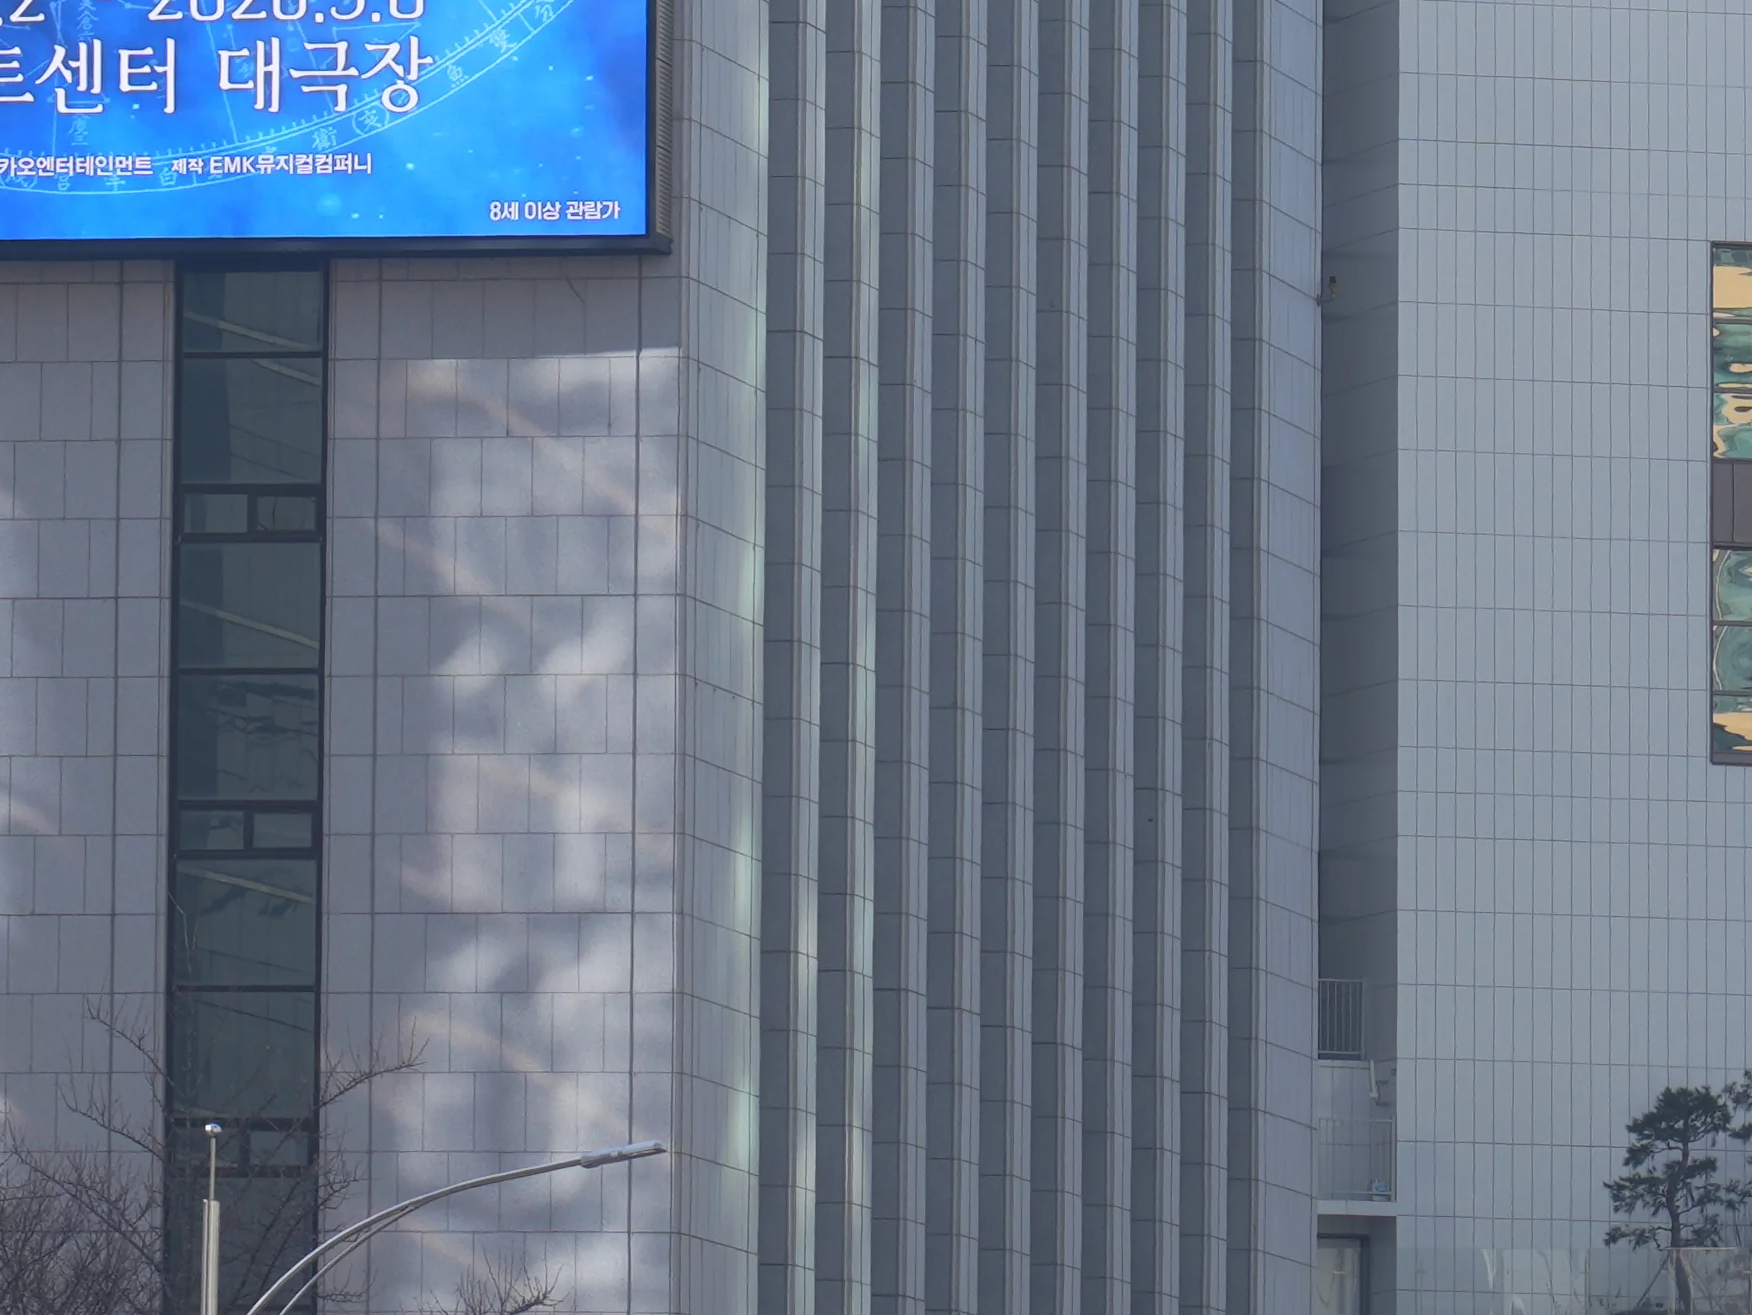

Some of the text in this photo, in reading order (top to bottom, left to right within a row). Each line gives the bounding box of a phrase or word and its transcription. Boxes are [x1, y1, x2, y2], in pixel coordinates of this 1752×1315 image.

[218, 35, 434, 114] 대극장
[171, 157, 205, 175] 제작
[209, 152, 372, 175] EMK뮤지컬컴퍼니
[489, 200, 622, 222] 8세 이상 관람가
